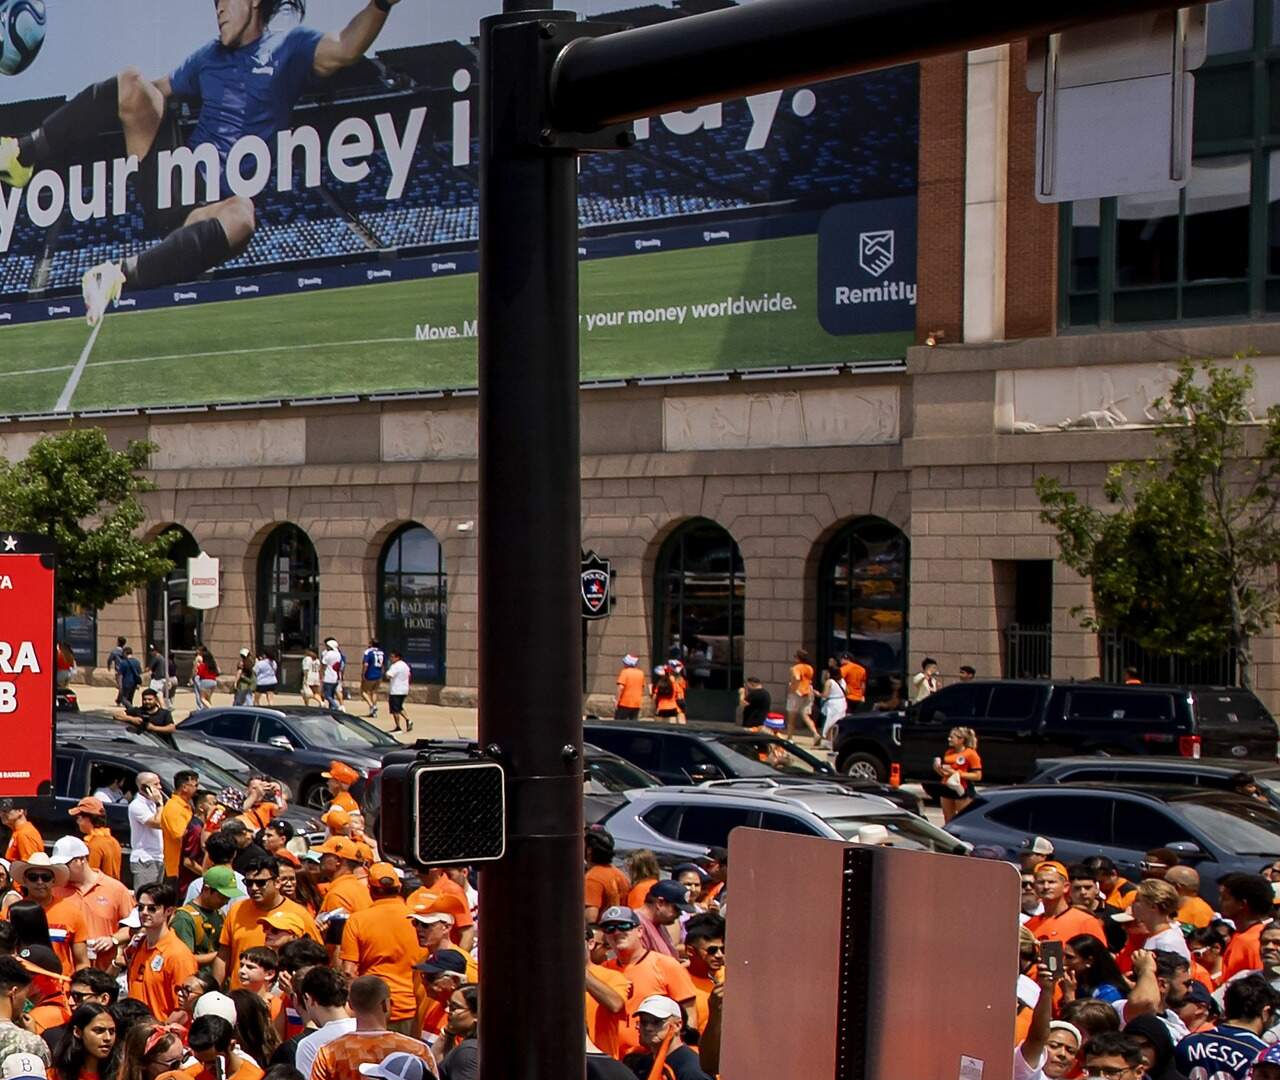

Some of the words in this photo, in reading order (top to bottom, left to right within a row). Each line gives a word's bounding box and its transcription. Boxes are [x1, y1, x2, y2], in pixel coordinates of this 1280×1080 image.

[157, 107, 427, 210] money
[836, 281, 917, 306] Remitly
[415, 322, 461, 341] Move.
[587, 309, 625, 331] your
[627, 303, 688, 327] money
[690, 293, 798, 319] worldwide.
[584, 574, 606, 584] POLICE
[404, 618, 435, 631] HOME
[3, 771, 31, 779] RANGERS
[21, 1057, 33, 1073] B
[1187, 1042, 1248, 1071] MESSI
